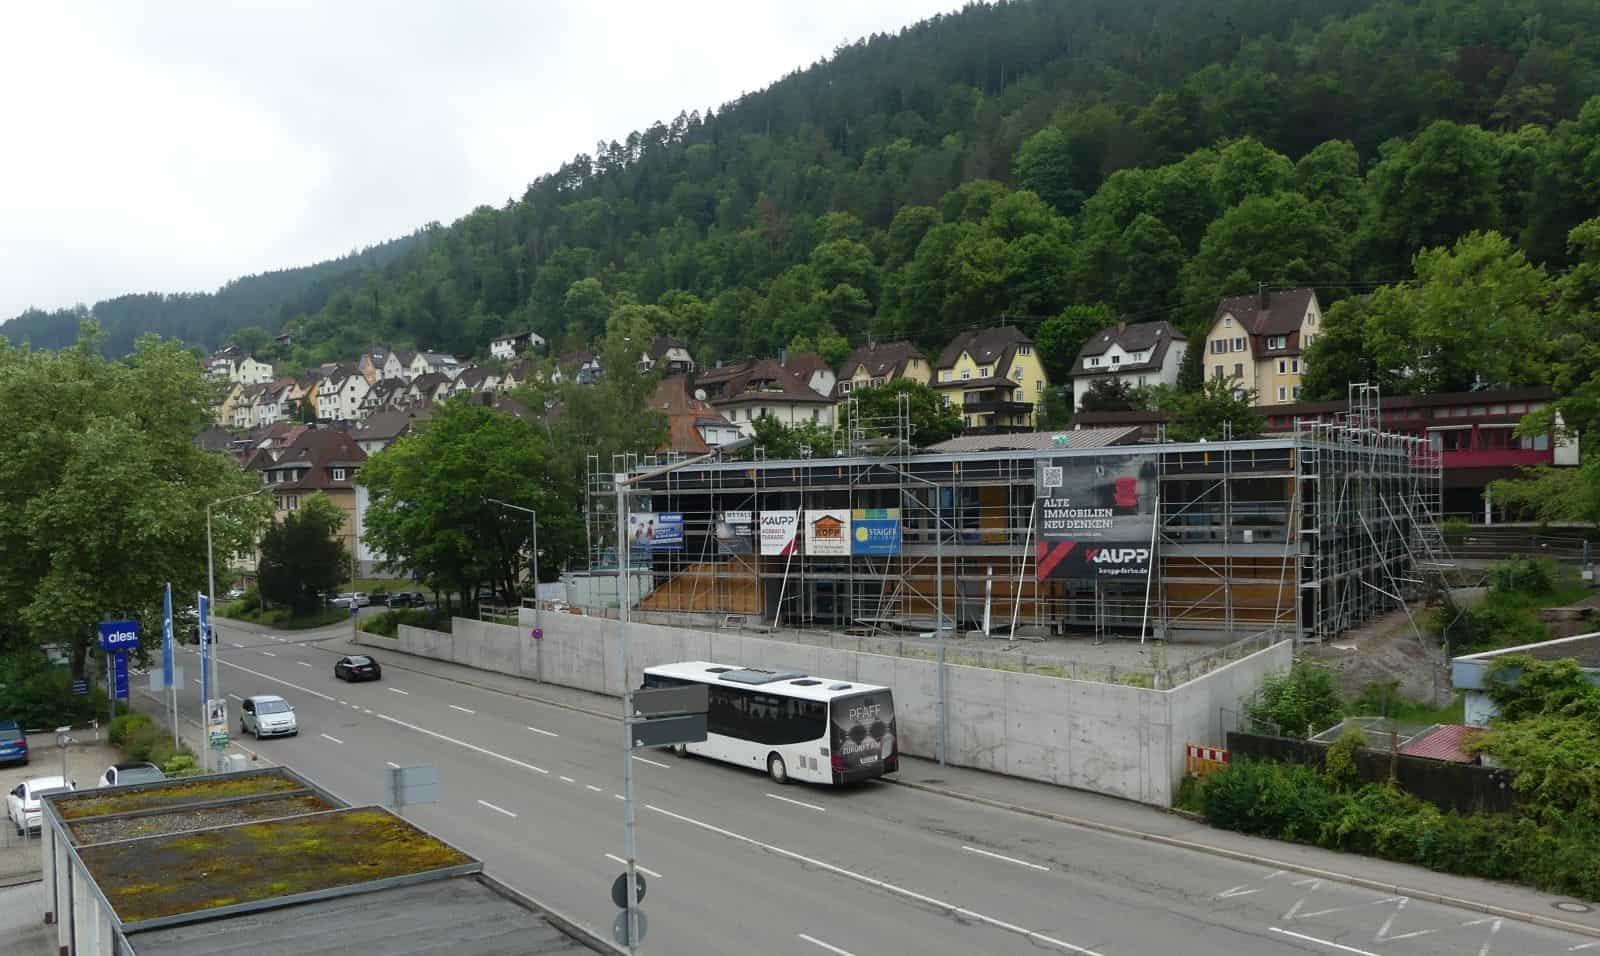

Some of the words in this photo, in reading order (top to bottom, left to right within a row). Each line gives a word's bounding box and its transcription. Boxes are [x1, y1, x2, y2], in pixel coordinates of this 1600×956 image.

[1044, 499, 1070, 507] ALTE
[1044, 509, 1113, 518] IMMOBILIEN
[761, 516, 794, 525] KAUPP
[1044, 520, 1065, 528] NEU
[1067, 519, 1113, 528] DENKEN!
[1085, 548, 1149, 563] KAUPP
[848, 704, 881, 720] PFAFF
